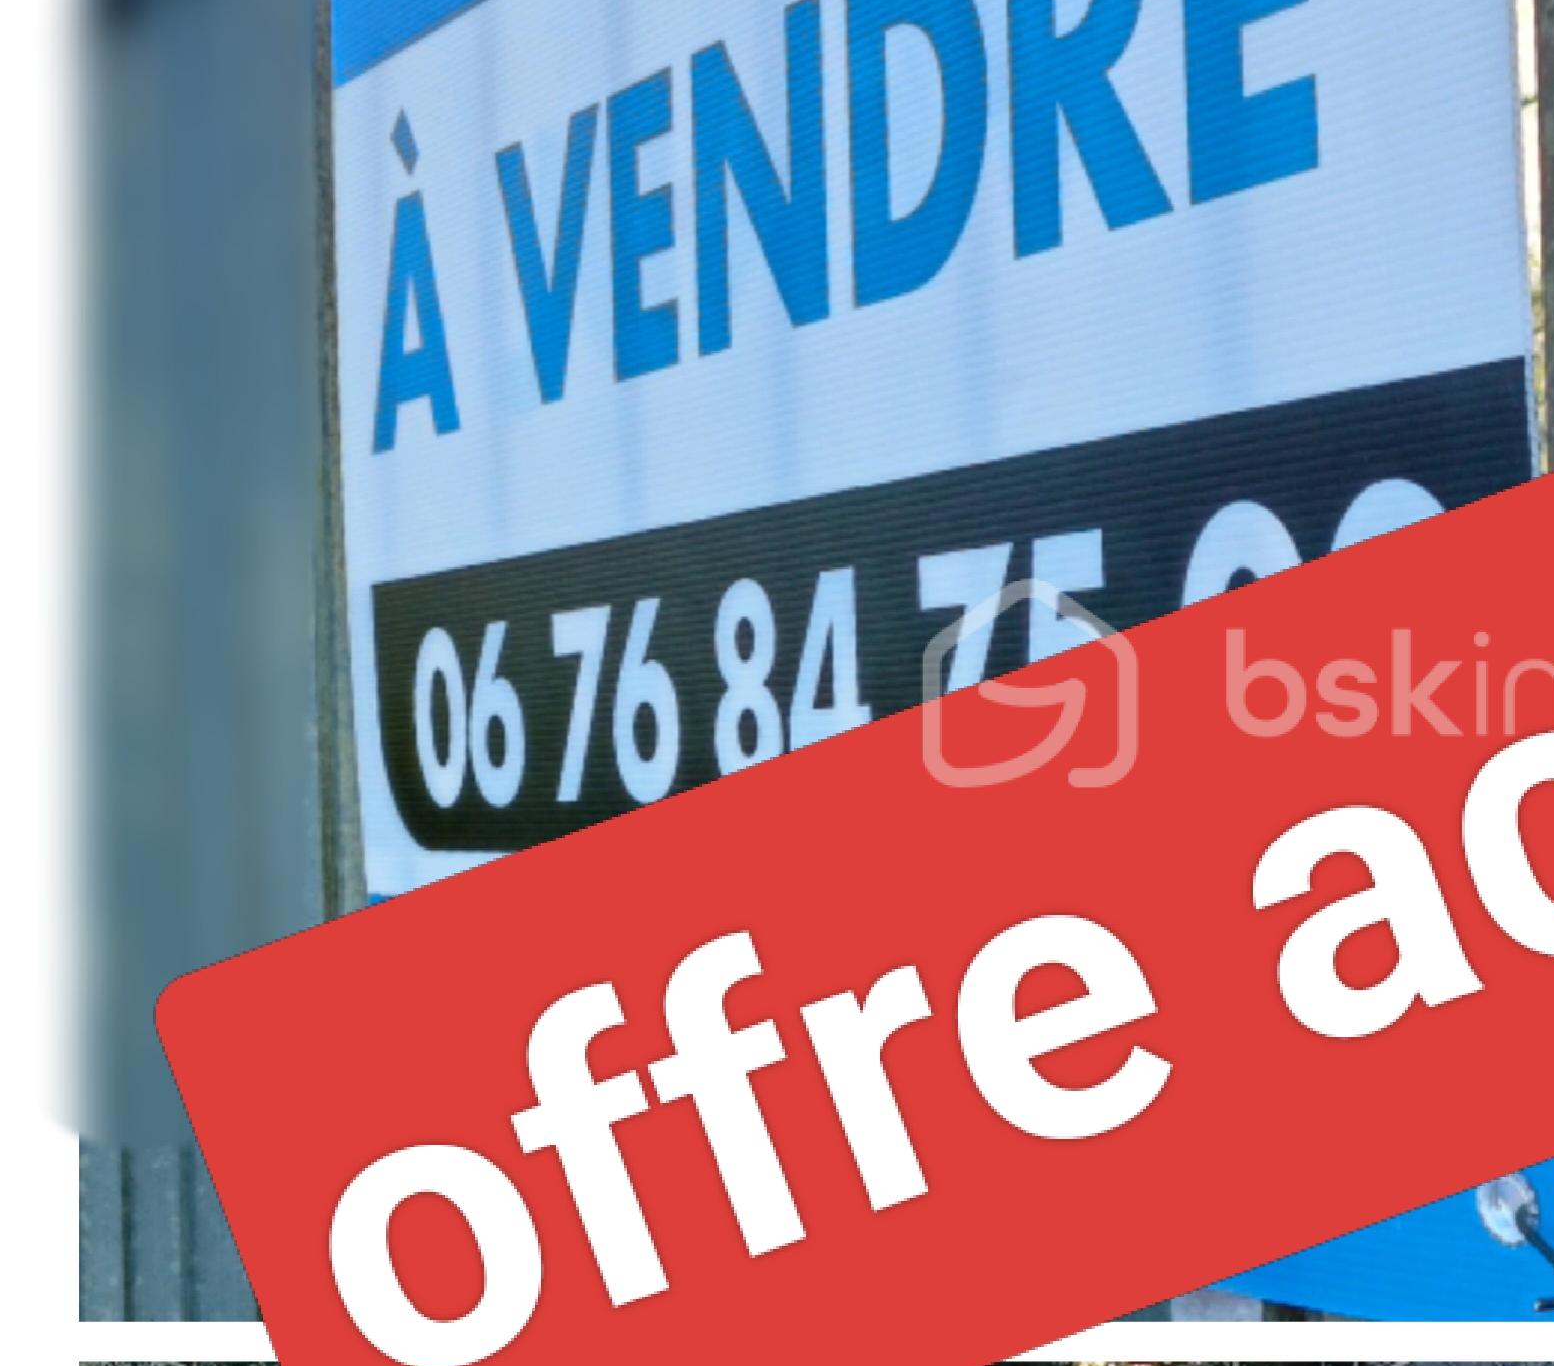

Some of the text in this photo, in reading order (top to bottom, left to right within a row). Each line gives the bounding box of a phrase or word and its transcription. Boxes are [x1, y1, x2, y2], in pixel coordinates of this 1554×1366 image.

[372, 109, 460, 456] À
[414, 622, 525, 809] 06
[550, 597, 680, 804] 76
[714, 566, 870, 776] 84
